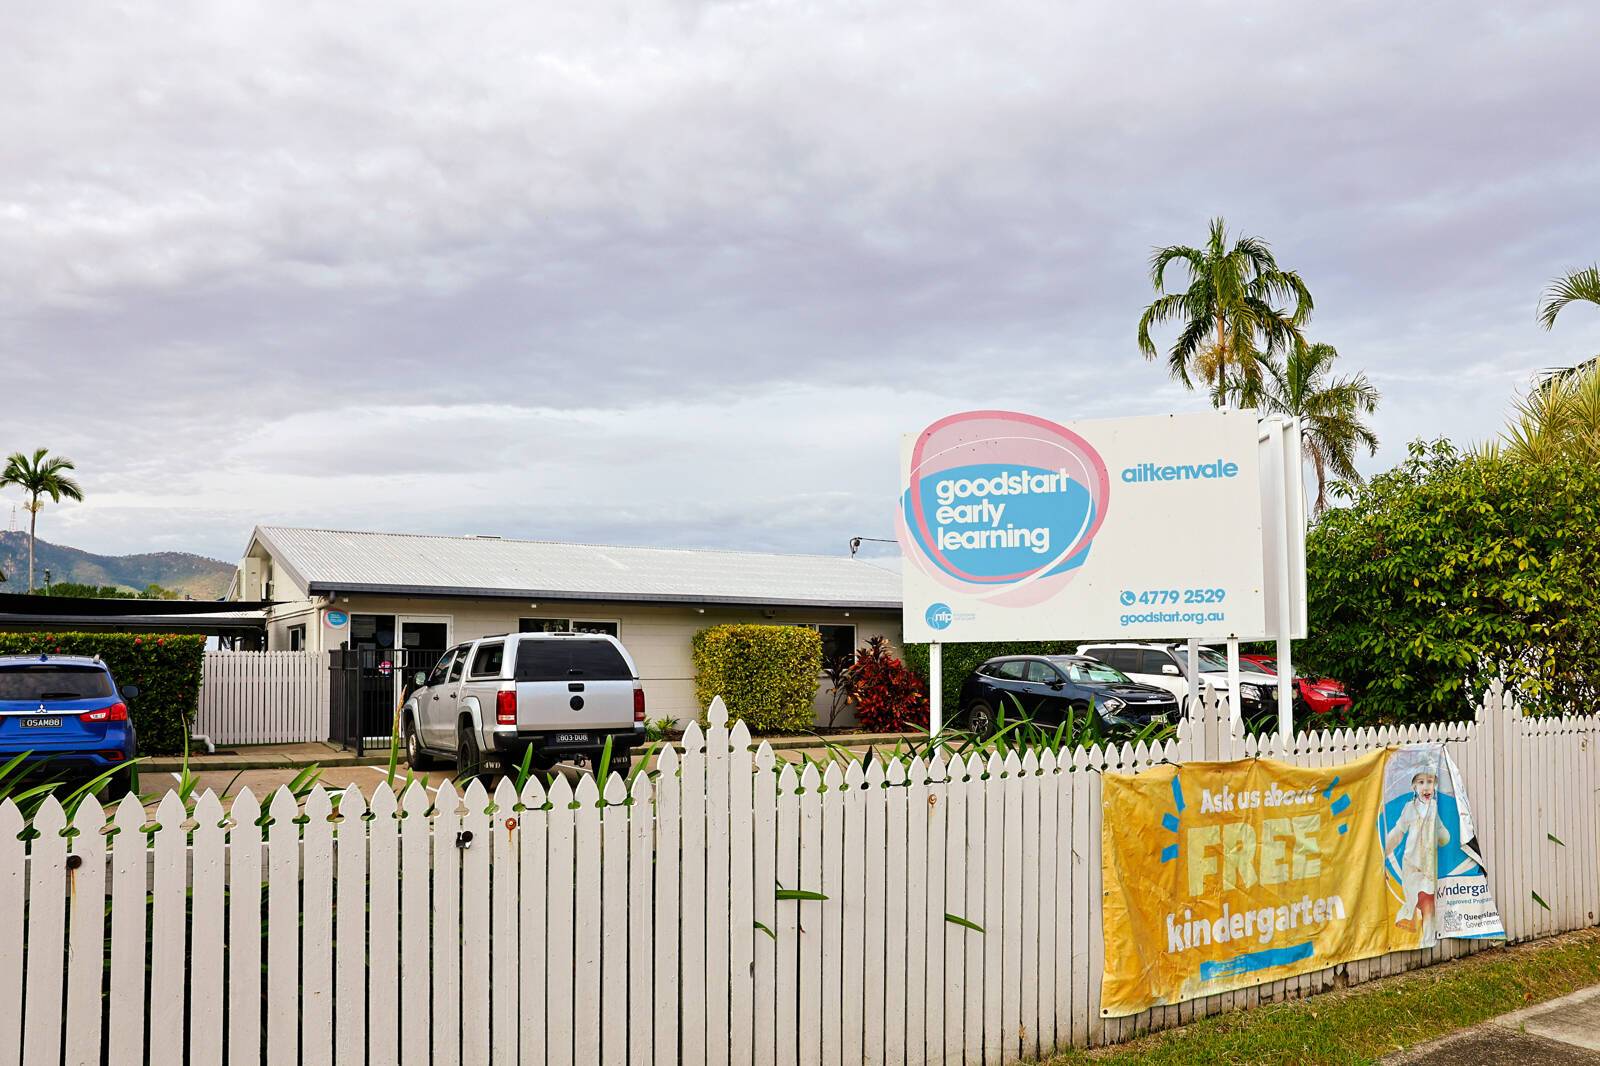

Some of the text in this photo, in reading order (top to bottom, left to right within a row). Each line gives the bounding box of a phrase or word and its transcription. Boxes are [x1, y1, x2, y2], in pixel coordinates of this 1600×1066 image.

[1121, 459, 1239, 483] aitkenvale
[936, 468, 1069, 505] goodstart
[936, 499, 1005, 527] early
[937, 523, 1050, 553] learning
[1138, 588, 1226, 605] 4779 2529
[1120, 611, 1225, 626] goodstart.org.au
[483, 761, 501, 769] 4WD
[1200, 782, 1317, 814] Ask us about
[1187, 814, 1321, 896] FREE
[1166, 895, 1346, 953] kindergarten
